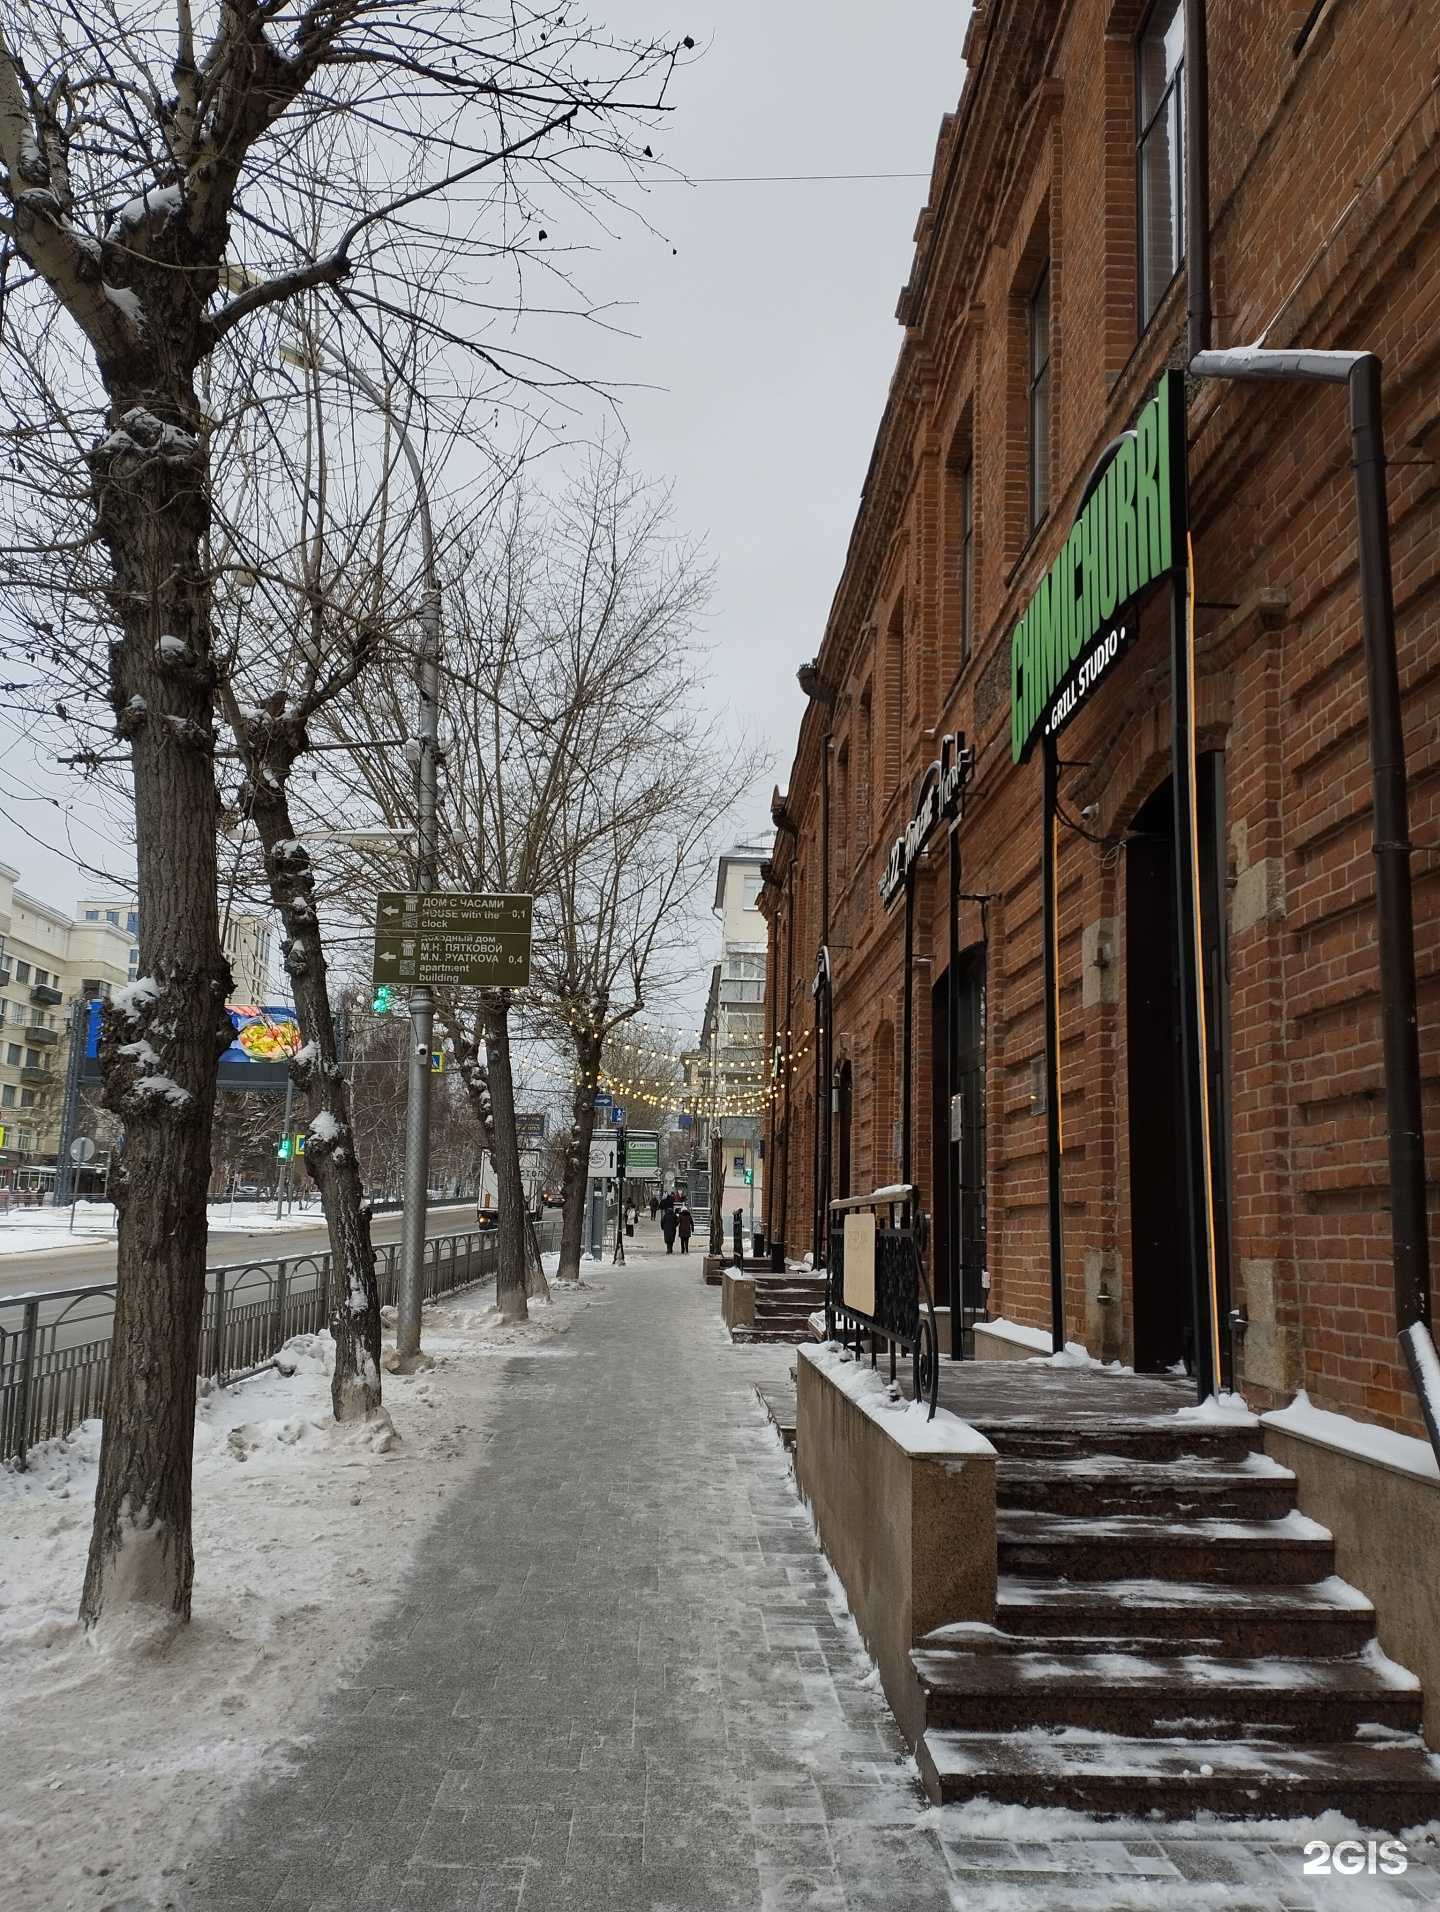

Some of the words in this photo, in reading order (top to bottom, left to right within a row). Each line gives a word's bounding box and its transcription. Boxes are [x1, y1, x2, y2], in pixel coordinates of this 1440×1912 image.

[1012, 370, 1172, 766] CHIMICHURRI
[1051, 682, 1079, 732] GRILL
[1078, 629, 1118, 696] STUDIO
[422, 898, 447, 908] ДОМ
[450, 898, 458, 907] С
[460, 899, 504, 908] ЧАСАМИ
[422, 909, 459, 919] HOUSE
[512, 909, 525, 919] 0,1
[422, 920, 448, 928] clock
[445, 943, 503, 953] ПЯТКОВОЙ
[445, 954, 499, 963] PYATKOVA
[508, 955, 523, 965] 0,4
[420, 964, 470, 973] apartment
[419, 973, 459, 983] building
